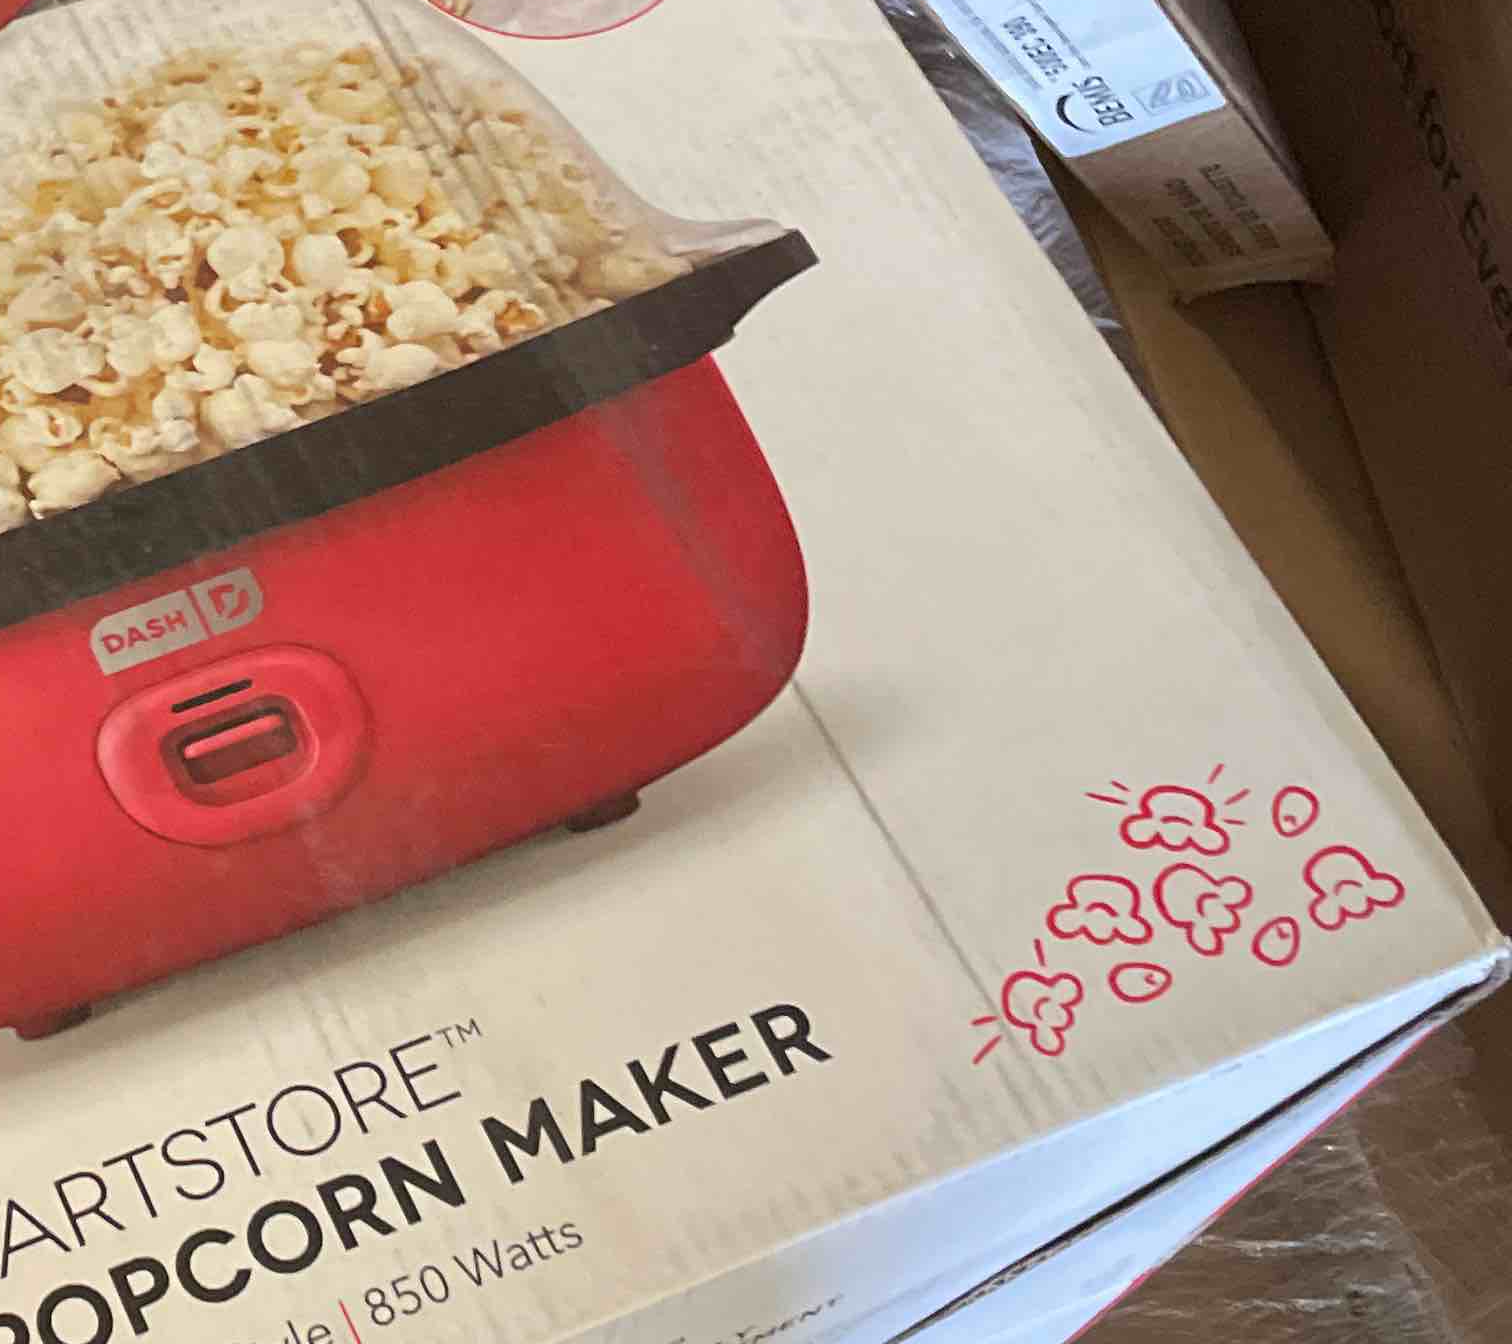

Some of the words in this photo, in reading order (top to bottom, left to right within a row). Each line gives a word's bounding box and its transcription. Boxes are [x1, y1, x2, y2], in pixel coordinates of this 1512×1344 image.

[101, 609, 187, 655] DASH
[480, 1000, 836, 1187] MAKER
[364, 1261, 453, 1330] 850
[454, 1214, 586, 1291] Watts
